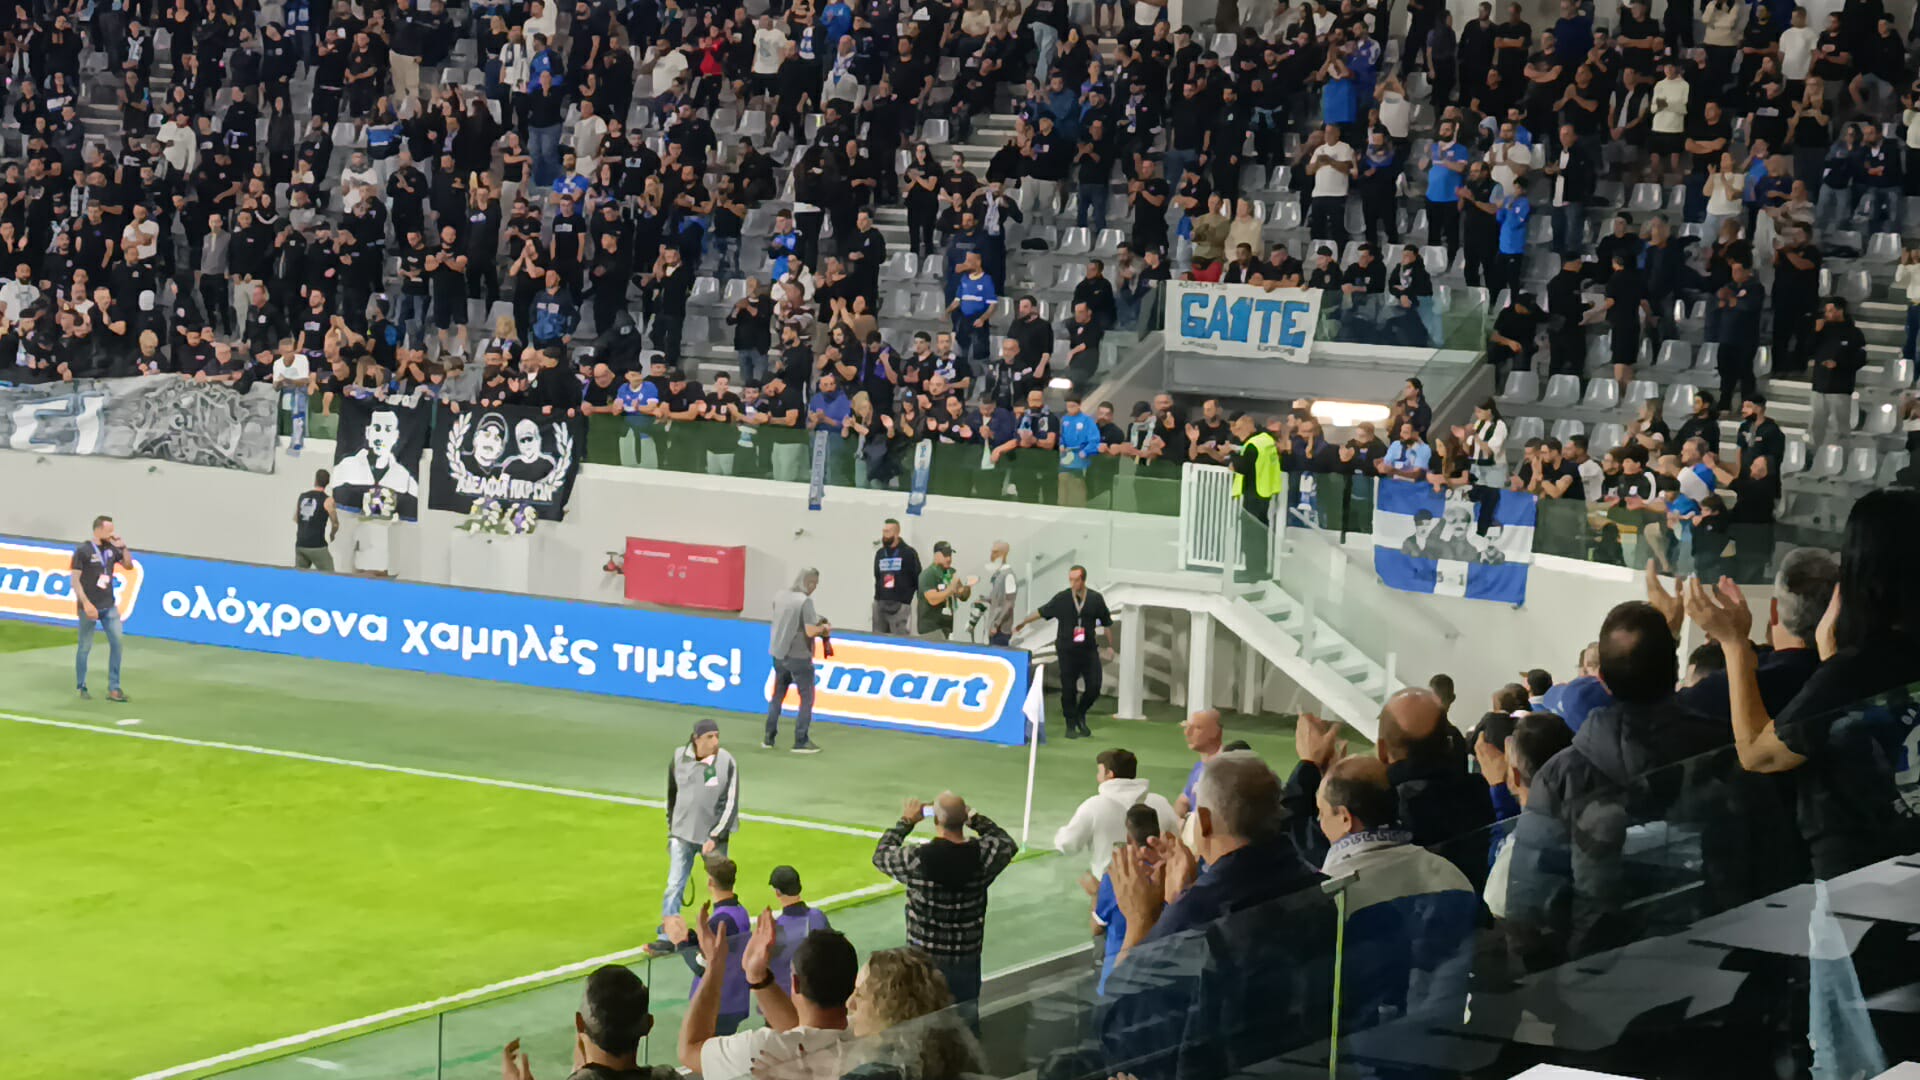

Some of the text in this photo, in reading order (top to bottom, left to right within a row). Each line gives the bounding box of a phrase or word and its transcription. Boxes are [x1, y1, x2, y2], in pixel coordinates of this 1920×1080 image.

[162, 585, 741, 692] ολόχρονα χαμηλές τιμές!
